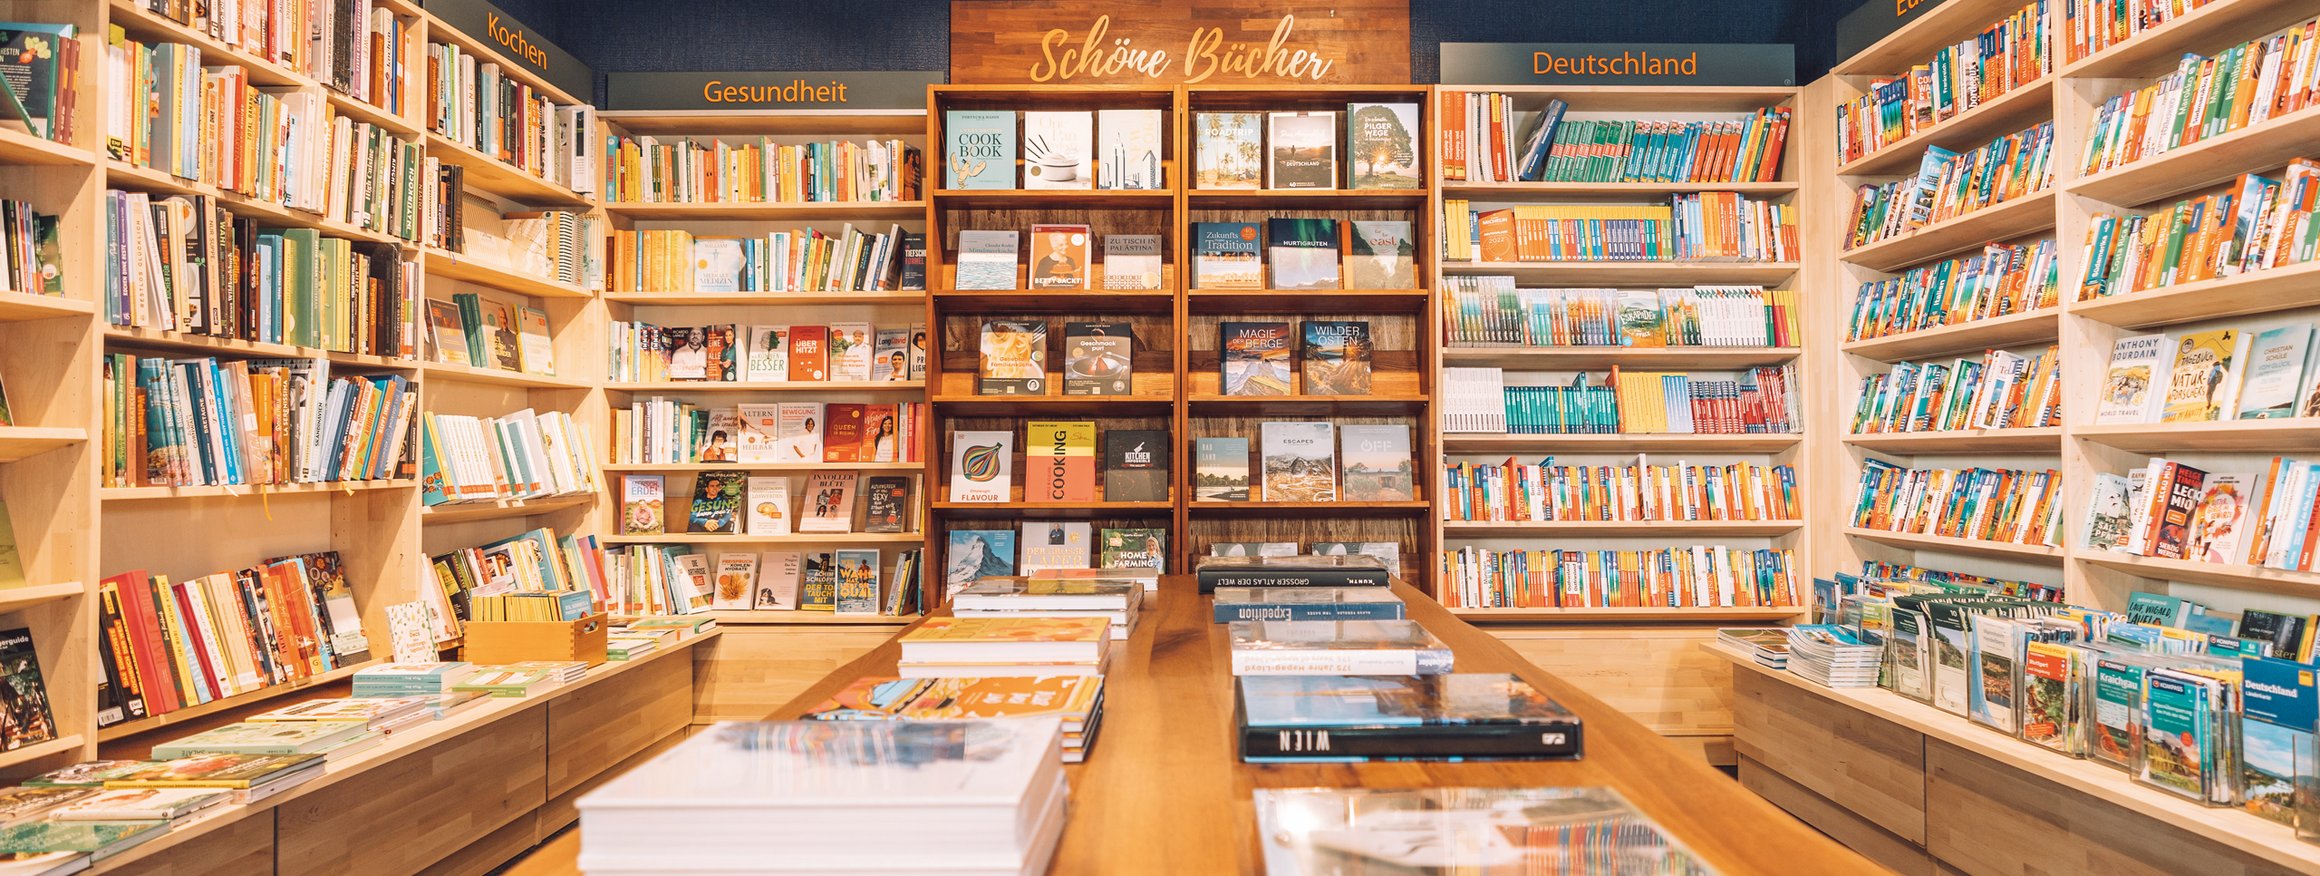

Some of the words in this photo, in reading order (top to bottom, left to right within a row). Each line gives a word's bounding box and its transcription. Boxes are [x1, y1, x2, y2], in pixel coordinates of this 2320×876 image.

[488, 12, 547, 70] Kochen
[1030, 14, 1172, 82] Schöne
[1183, 14, 1333, 84] Bücher
[1533, 51, 1697, 75] Deutschland
[2209, 64, 2225, 104] Mauritius
[2225, 56, 2242, 100] Namibia
[704, 80, 848, 103] Gesundheit
[1968, 62, 1978, 108] bordeaux
[2178, 76, 2194, 116] Marokko
[1205, 128, 1254, 136] ROADTRIP
[958, 133, 1002, 146] COOK
[959, 146, 1002, 157] BOOK
[1482, 217, 1508, 225] MICHELIN
[2171, 214, 2182, 235] Peru
[2252, 208, 2268, 248] Florida
[2283, 213, 2298, 244] YORK
[1206, 231, 1239, 239] Zukunfts
[1205, 240, 1253, 250] Tradition
[2111, 248, 2122, 273] Costa
[2118, 227, 2127, 248] Rica
[2092, 235, 2108, 278] Südamerika
[2279, 246, 2290, 264] NEW
[1034, 277, 1057, 285] BETTY
[1934, 280, 1945, 306] Italien
[1239, 329, 1276, 338] MAGIE
[1315, 326, 1360, 336] WILDER
[1245, 339, 1283, 348] BERGE
[1318, 336, 1358, 346] OSTEN
[2115, 338, 2160, 350] ANTHONY
[2112, 349, 2158, 361] BOURDAIN
[2263, 344, 2294, 355] CHRISTIAN
[2180, 351, 2214, 366] TAGEBUCH
[2265, 352, 2288, 362] SCHÜLE
[750, 360, 784, 371] BESSER
[2171, 370, 2206, 387] NATUR-
[315, 402, 323, 447] SKANDINAVIEN
[1125, 452, 1150, 460] KITCHEN
[1052, 430, 1068, 500] COOKING
[2158, 478, 2168, 503] LECKO
[2164, 465, 2173, 478] MIO
[691, 500, 739, 512] GESUND
[2170, 498, 2193, 511] MIO
[2157, 548, 2180, 559] WERDEN
[1114, 560, 1154, 568] FARMING
[840, 588, 874, 598] QUAL
[1239, 606, 1291, 621] Expedition
[2129, 602, 2144, 614] LAUF,
[2145, 606, 2172, 617] WIGALD,
[2217, 637, 2240, 649] KOMPASS
[2028, 659, 2048, 668] Stuttgart
[2106, 661, 2126, 672] KOMPASS
[2100, 672, 2138, 690] Kraichgau
[2160, 682, 2184, 693] KOMPASS
[2245, 679, 2298, 698] Deutschland
[2245, 691, 2272, 700] Länderkarte
[1280, 730, 1330, 752] WIEN
